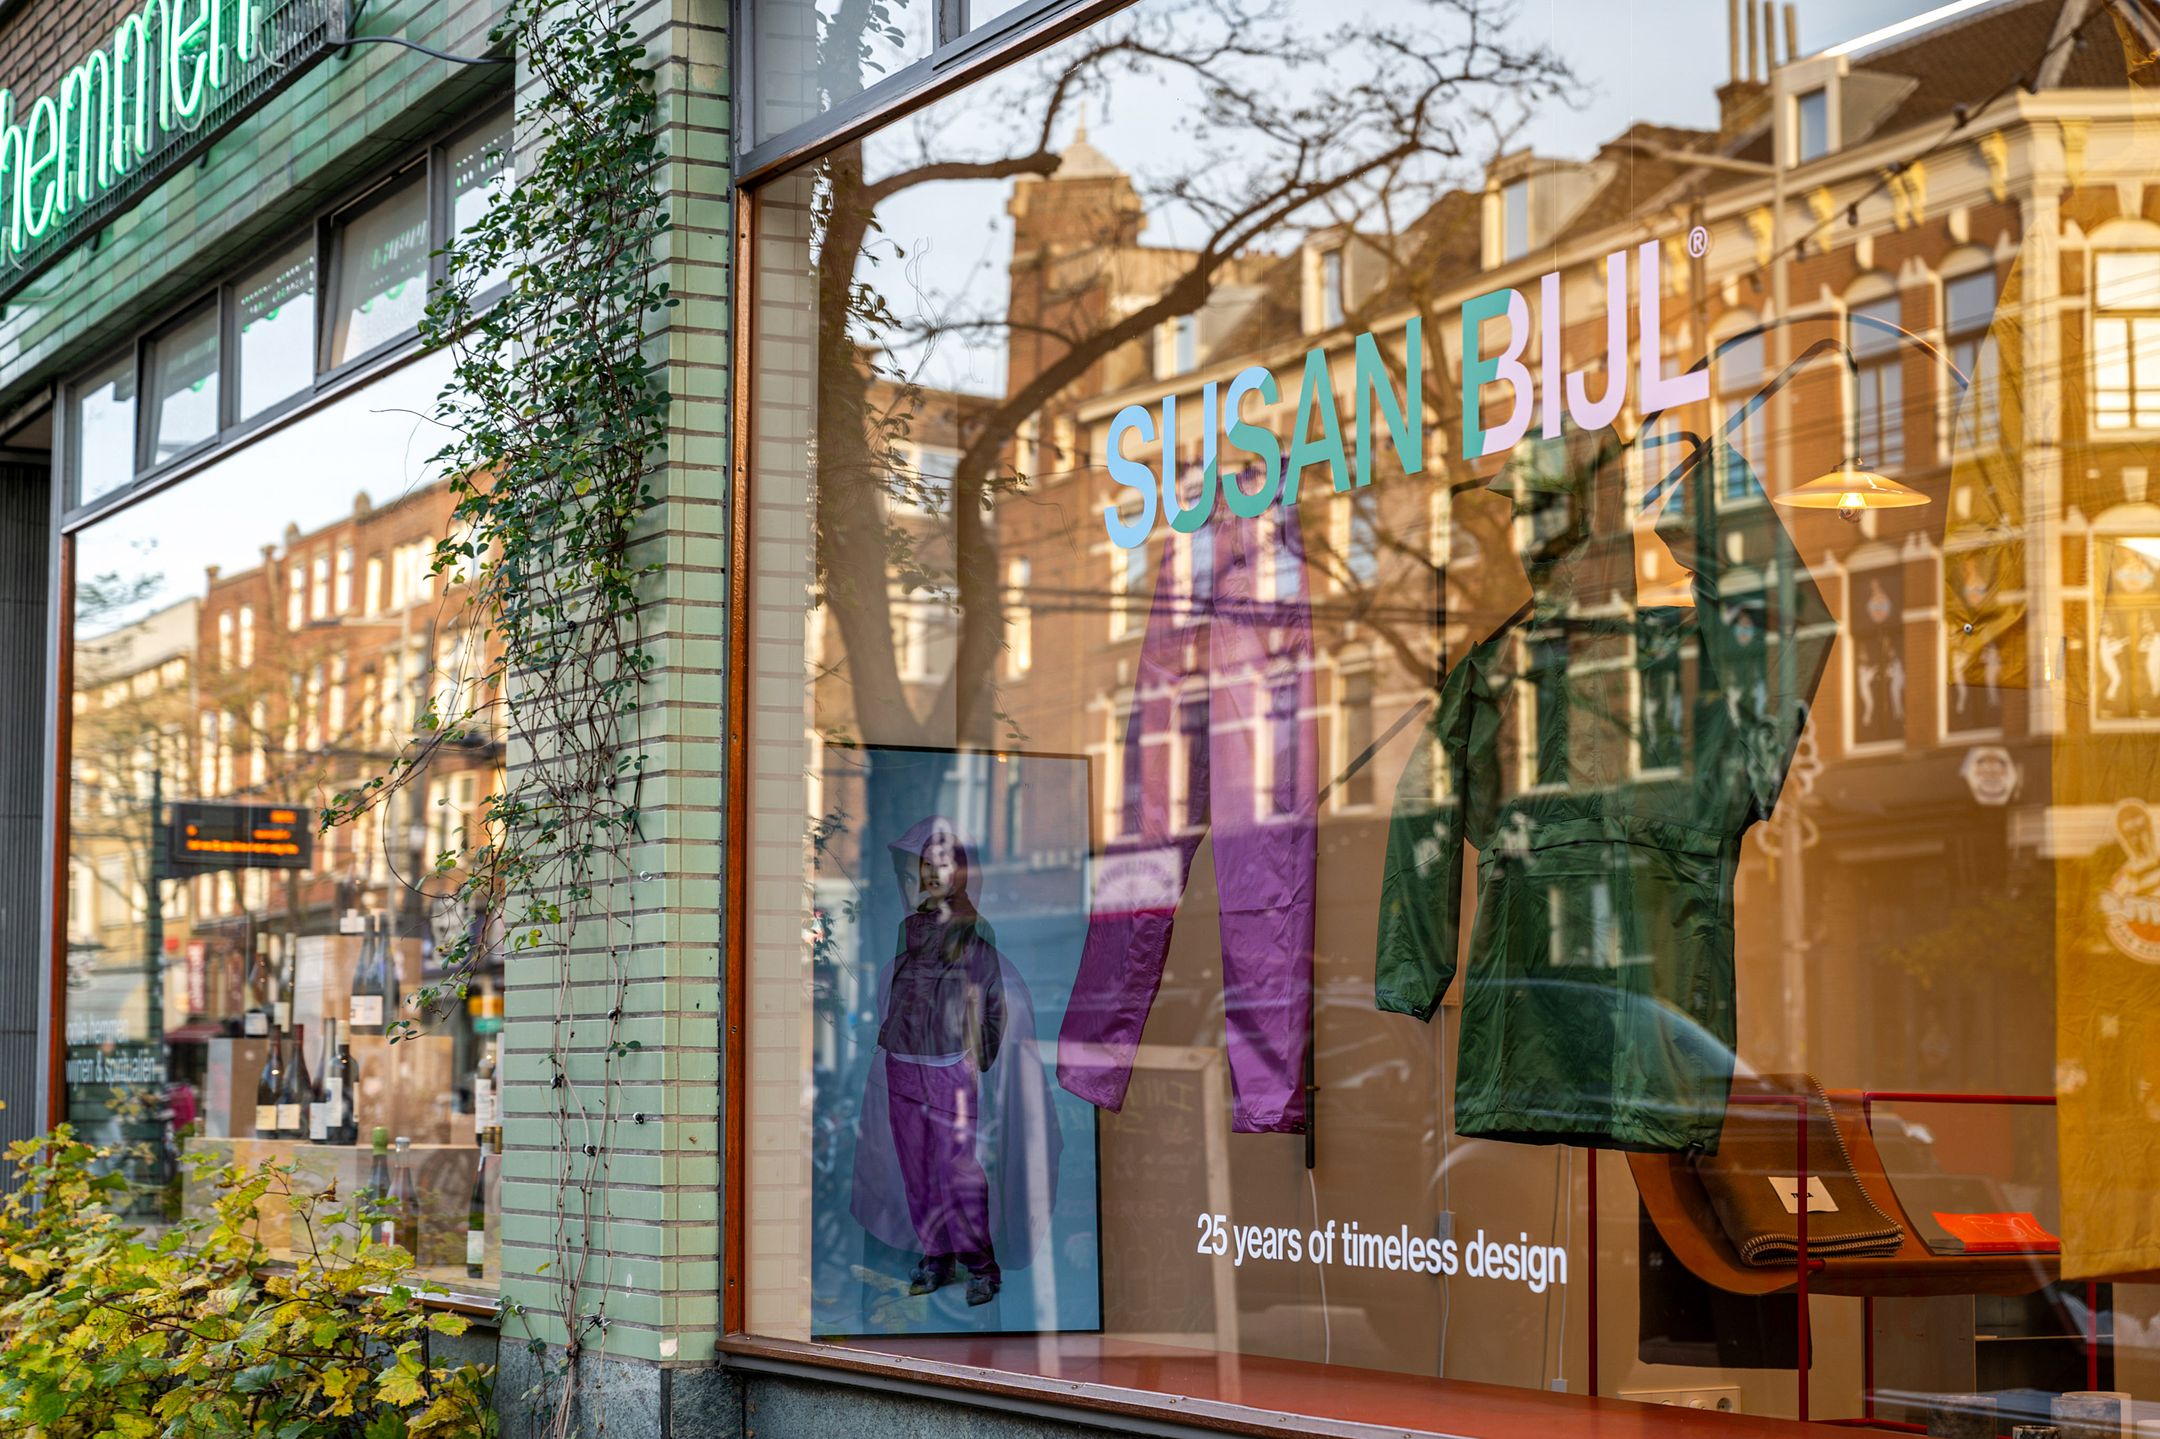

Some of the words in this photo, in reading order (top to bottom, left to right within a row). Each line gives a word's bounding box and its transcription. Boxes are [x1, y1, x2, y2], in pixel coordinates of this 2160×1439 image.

[1104, 316, 1423, 549] SUSAN
[1197, 1213, 1229, 1256] 25
[1233, 1223, 1303, 1267] years
[1308, 1220, 1336, 1264] of
[1342, 1221, 1458, 1276] timeless
[1465, 1229, 1568, 1294] design
